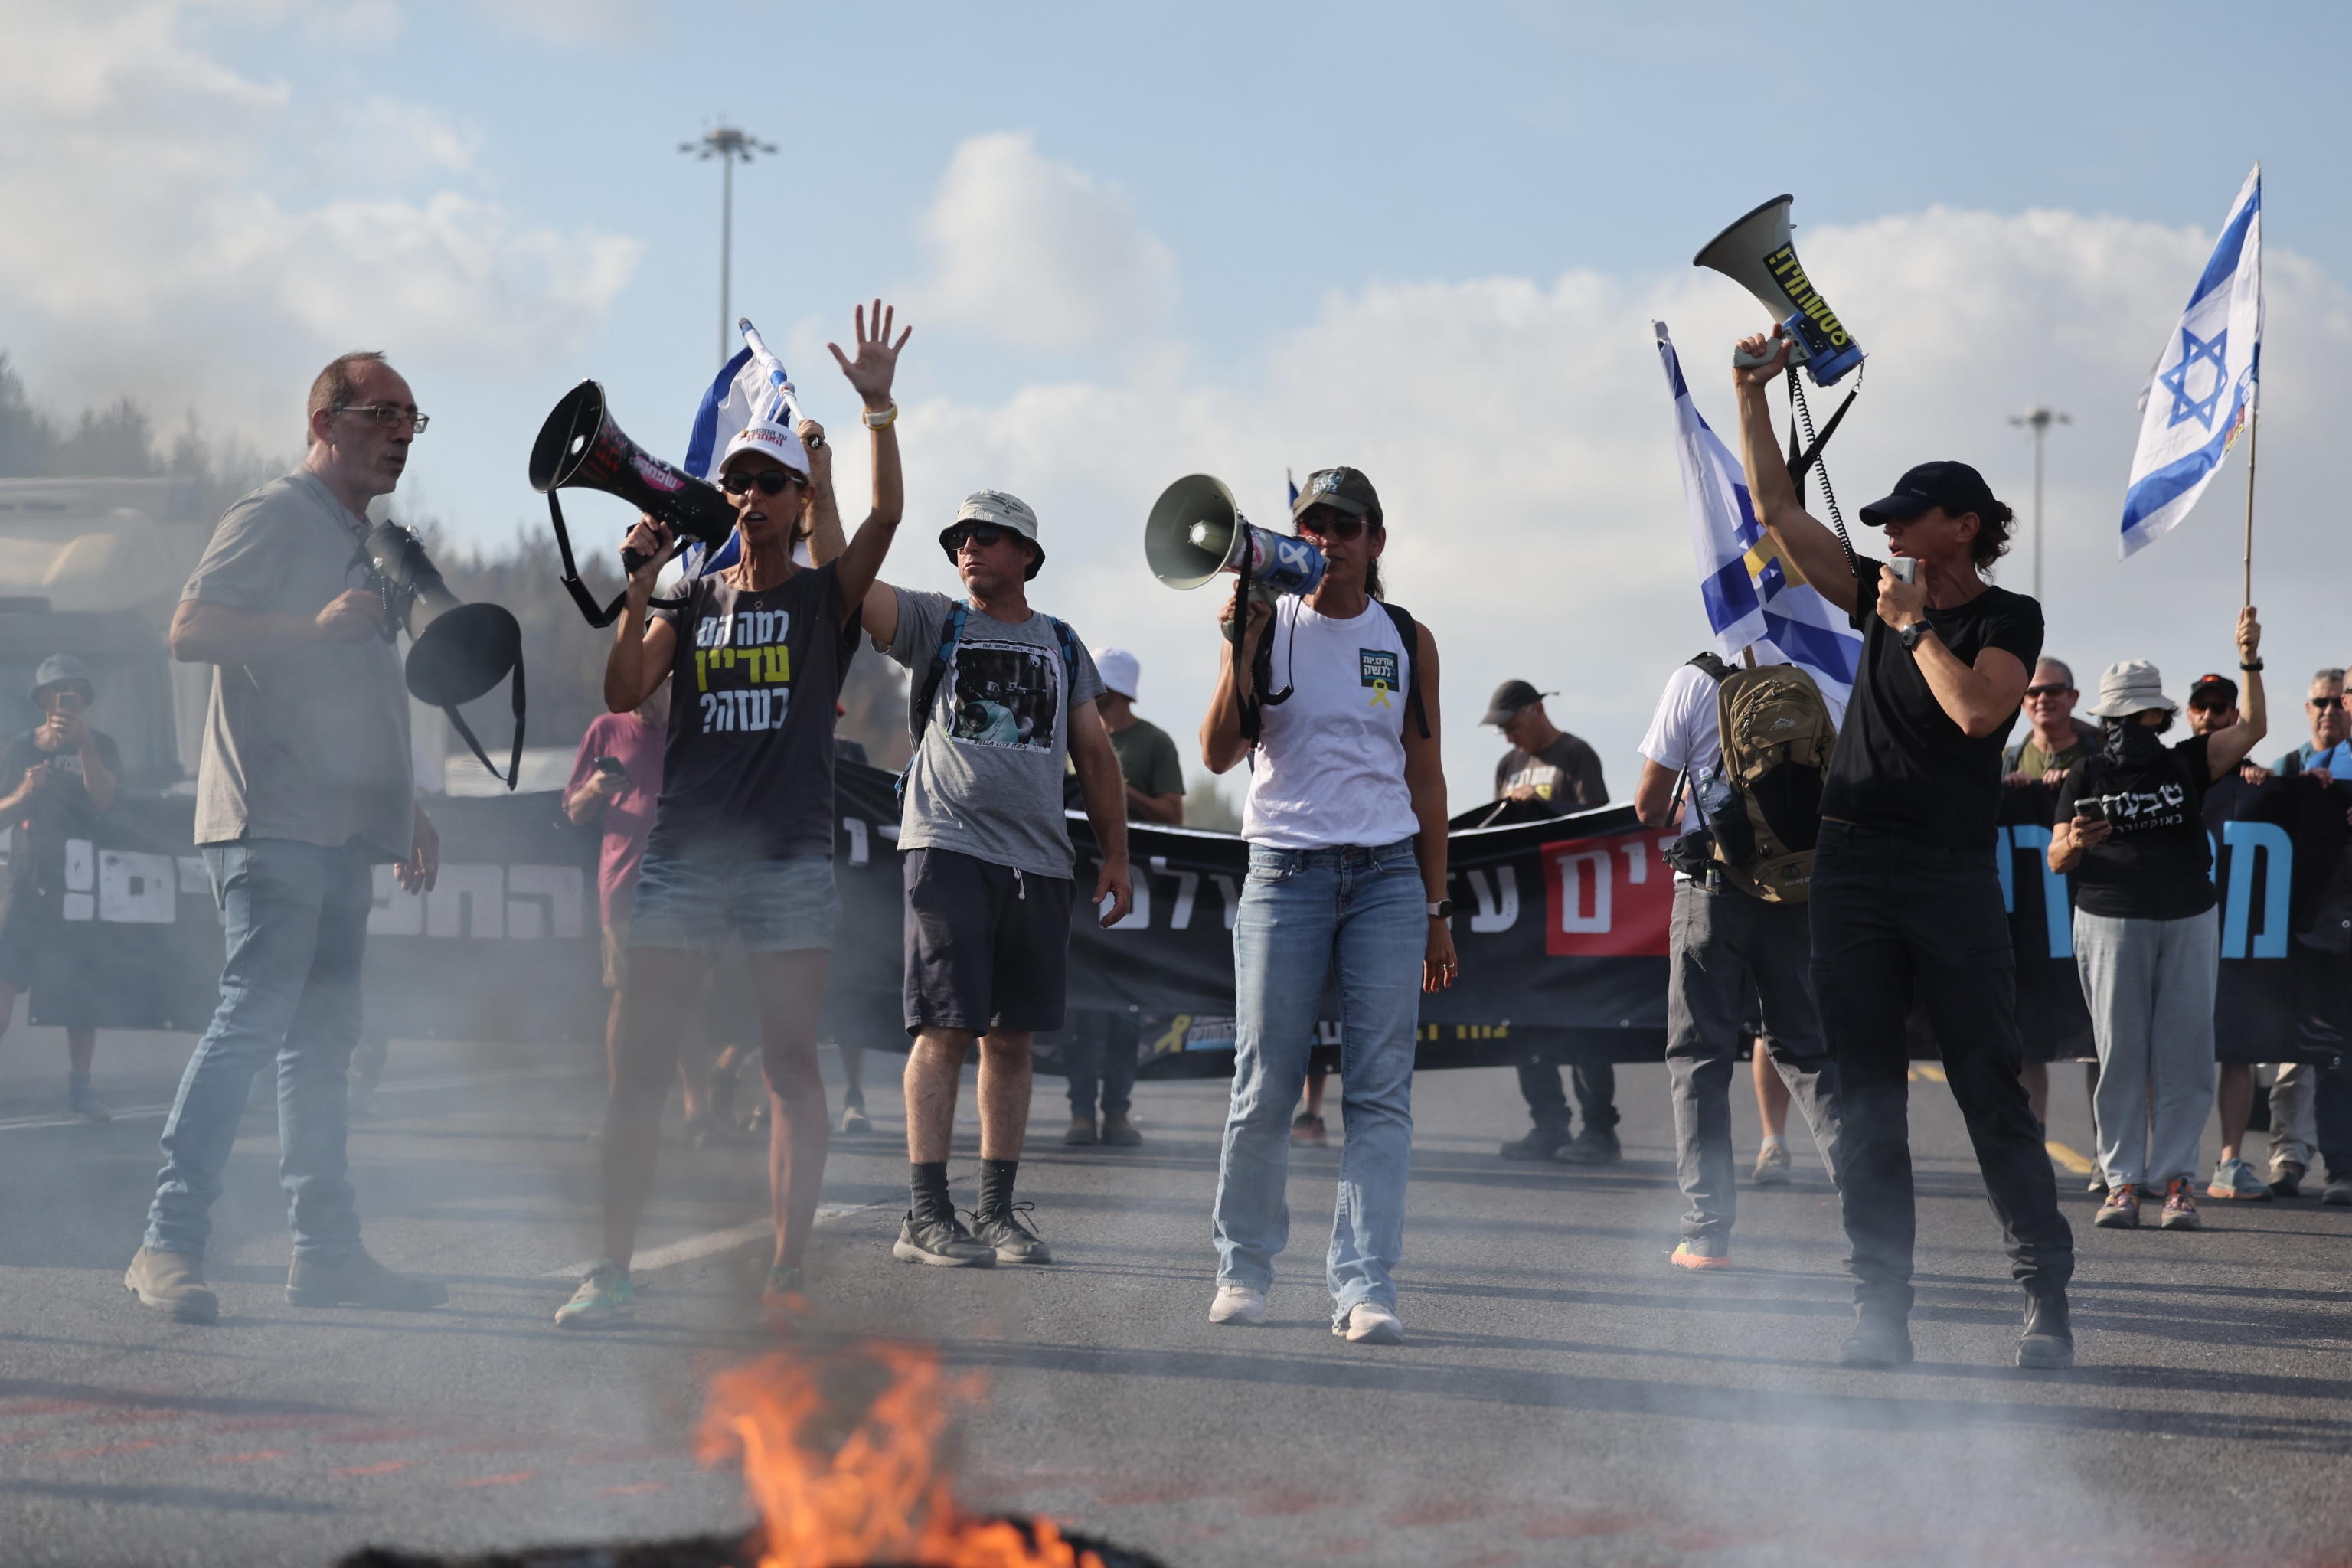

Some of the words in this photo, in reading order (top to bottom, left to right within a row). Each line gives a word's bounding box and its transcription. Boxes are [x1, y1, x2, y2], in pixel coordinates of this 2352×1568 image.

[696, 613, 734, 647] הם
[737, 609, 790, 646] למה
[694, 645, 790, 692] עדיין
